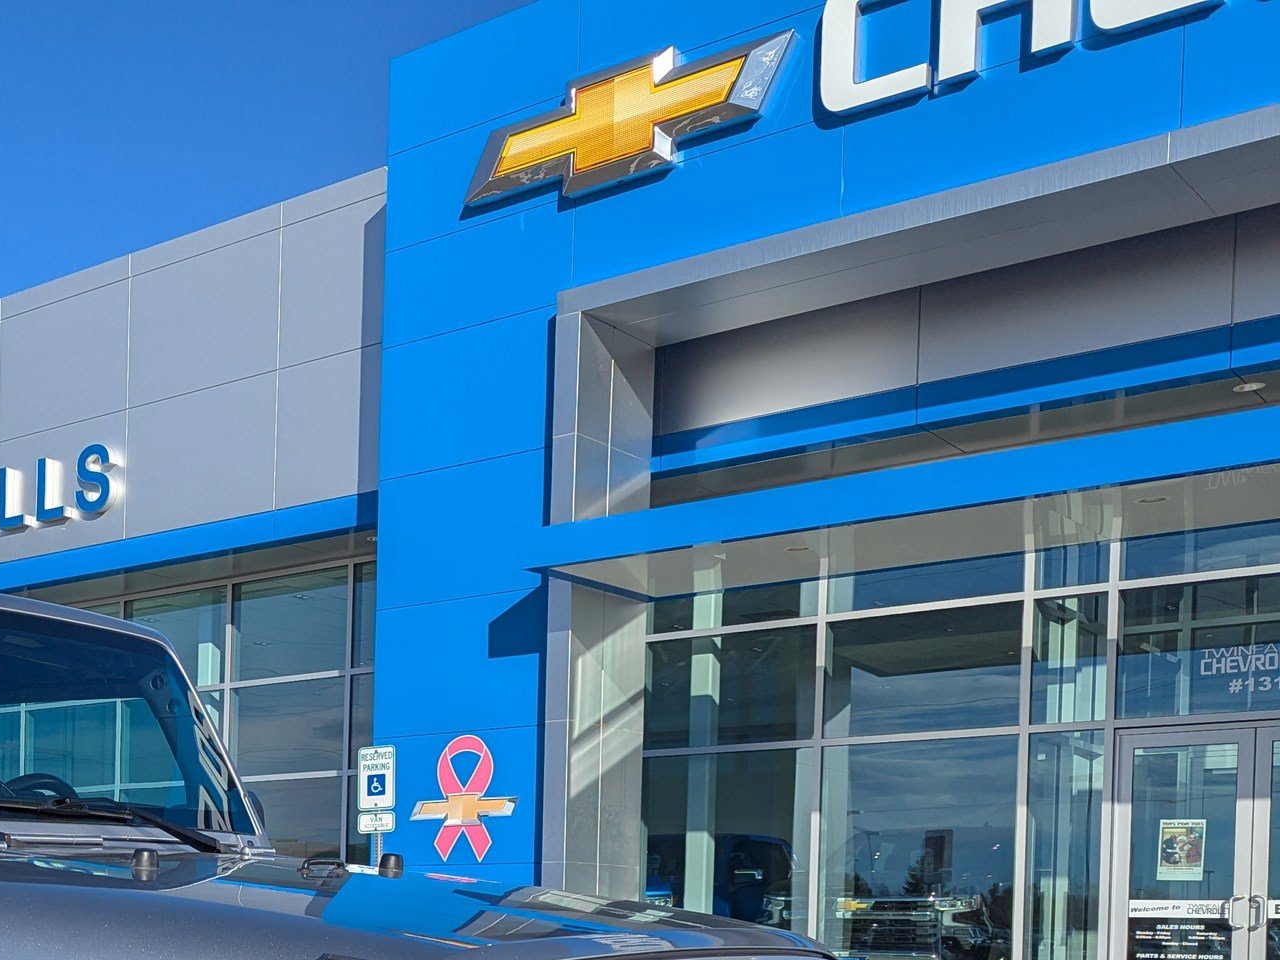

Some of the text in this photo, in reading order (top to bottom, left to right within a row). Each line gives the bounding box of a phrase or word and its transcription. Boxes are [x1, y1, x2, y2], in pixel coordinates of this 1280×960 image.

[361, 751, 393, 762] RESERVED
[363, 762, 391, 772] PARKING
[1130, 905, 1169, 913] Welcome
